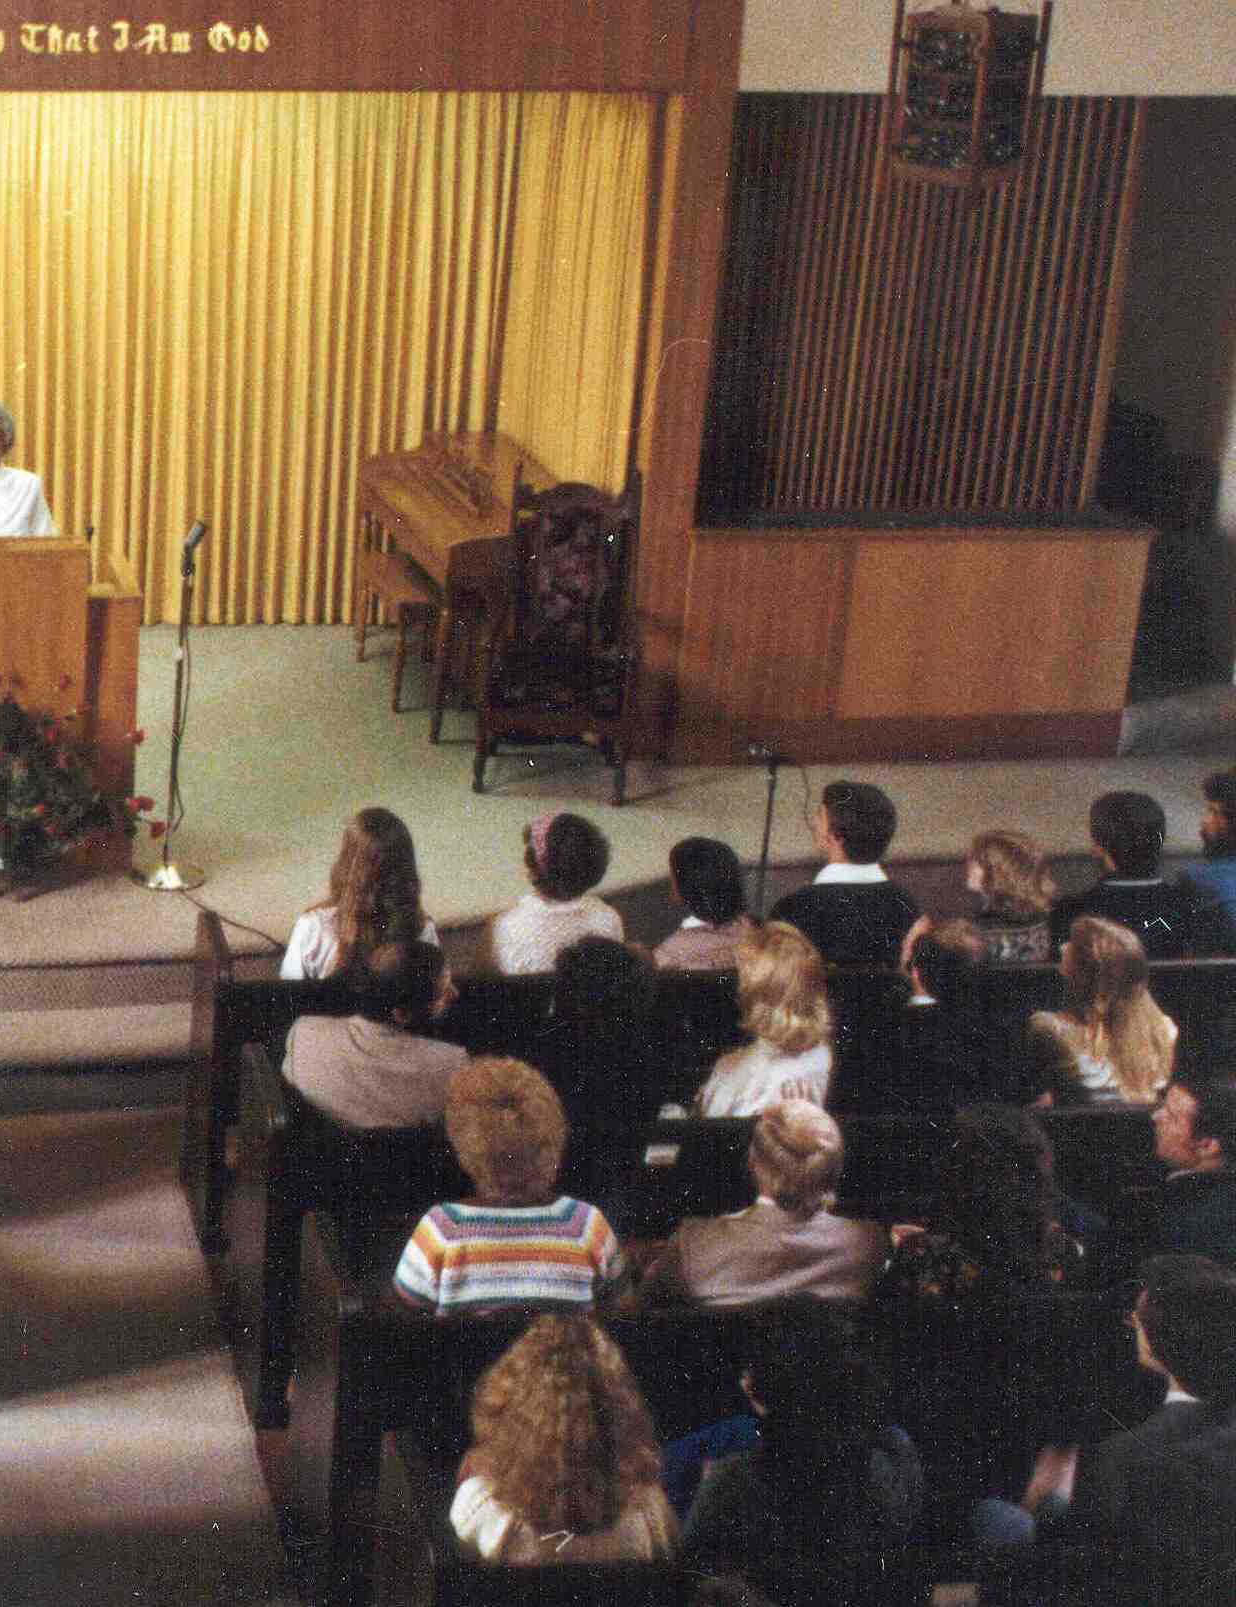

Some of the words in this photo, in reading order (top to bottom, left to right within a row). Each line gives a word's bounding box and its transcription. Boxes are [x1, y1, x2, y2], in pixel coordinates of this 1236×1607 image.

[20, 21, 100, 55] That
[111, 20, 130, 52] I
[133, 22, 191, 54] Am
[207, 20, 270, 53] God
